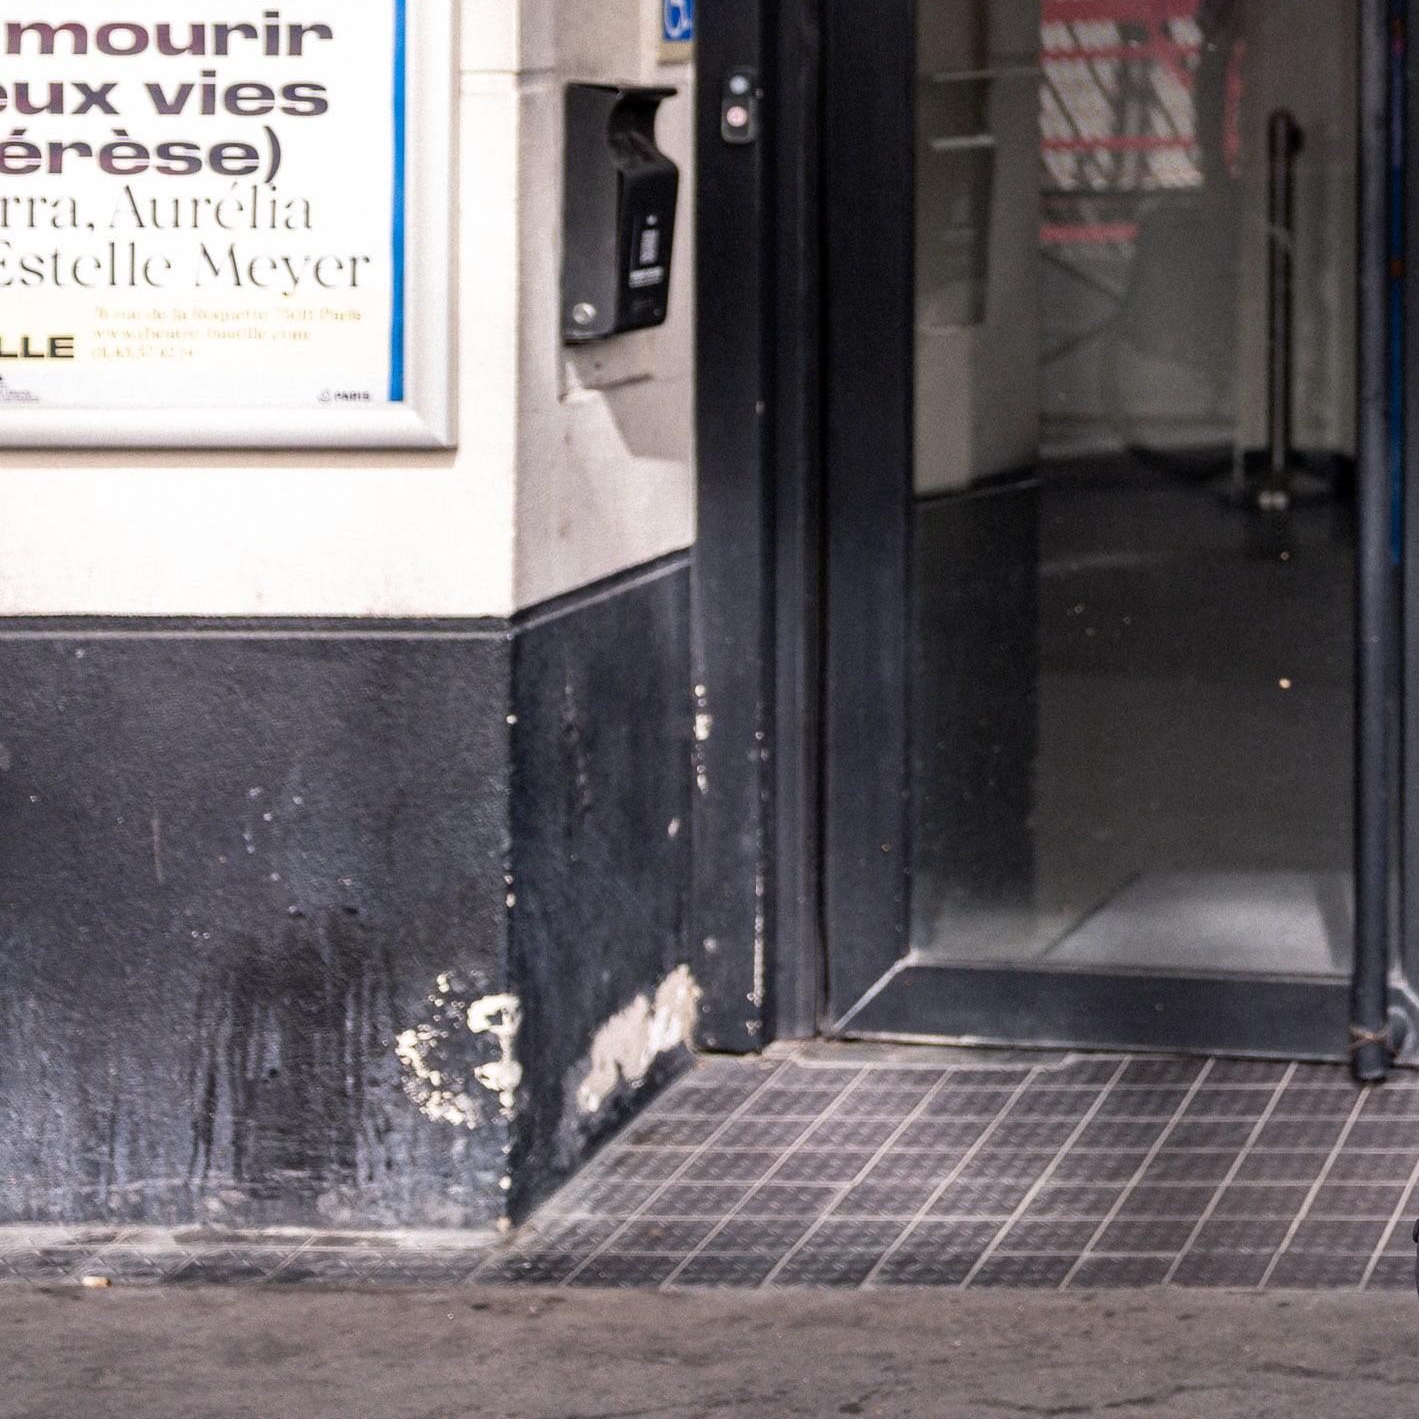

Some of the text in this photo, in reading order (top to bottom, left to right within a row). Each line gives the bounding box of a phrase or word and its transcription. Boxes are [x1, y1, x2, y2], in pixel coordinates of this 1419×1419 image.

[5, 10, 333, 57] mourir
[0, 69, 329, 117] ux vies
[0, 125, 282, 184] érèse)
[107, 181, 313, 230] Aurélia
[195, 242, 371, 296] Meyer
[0, 336, 74, 359] LLE
